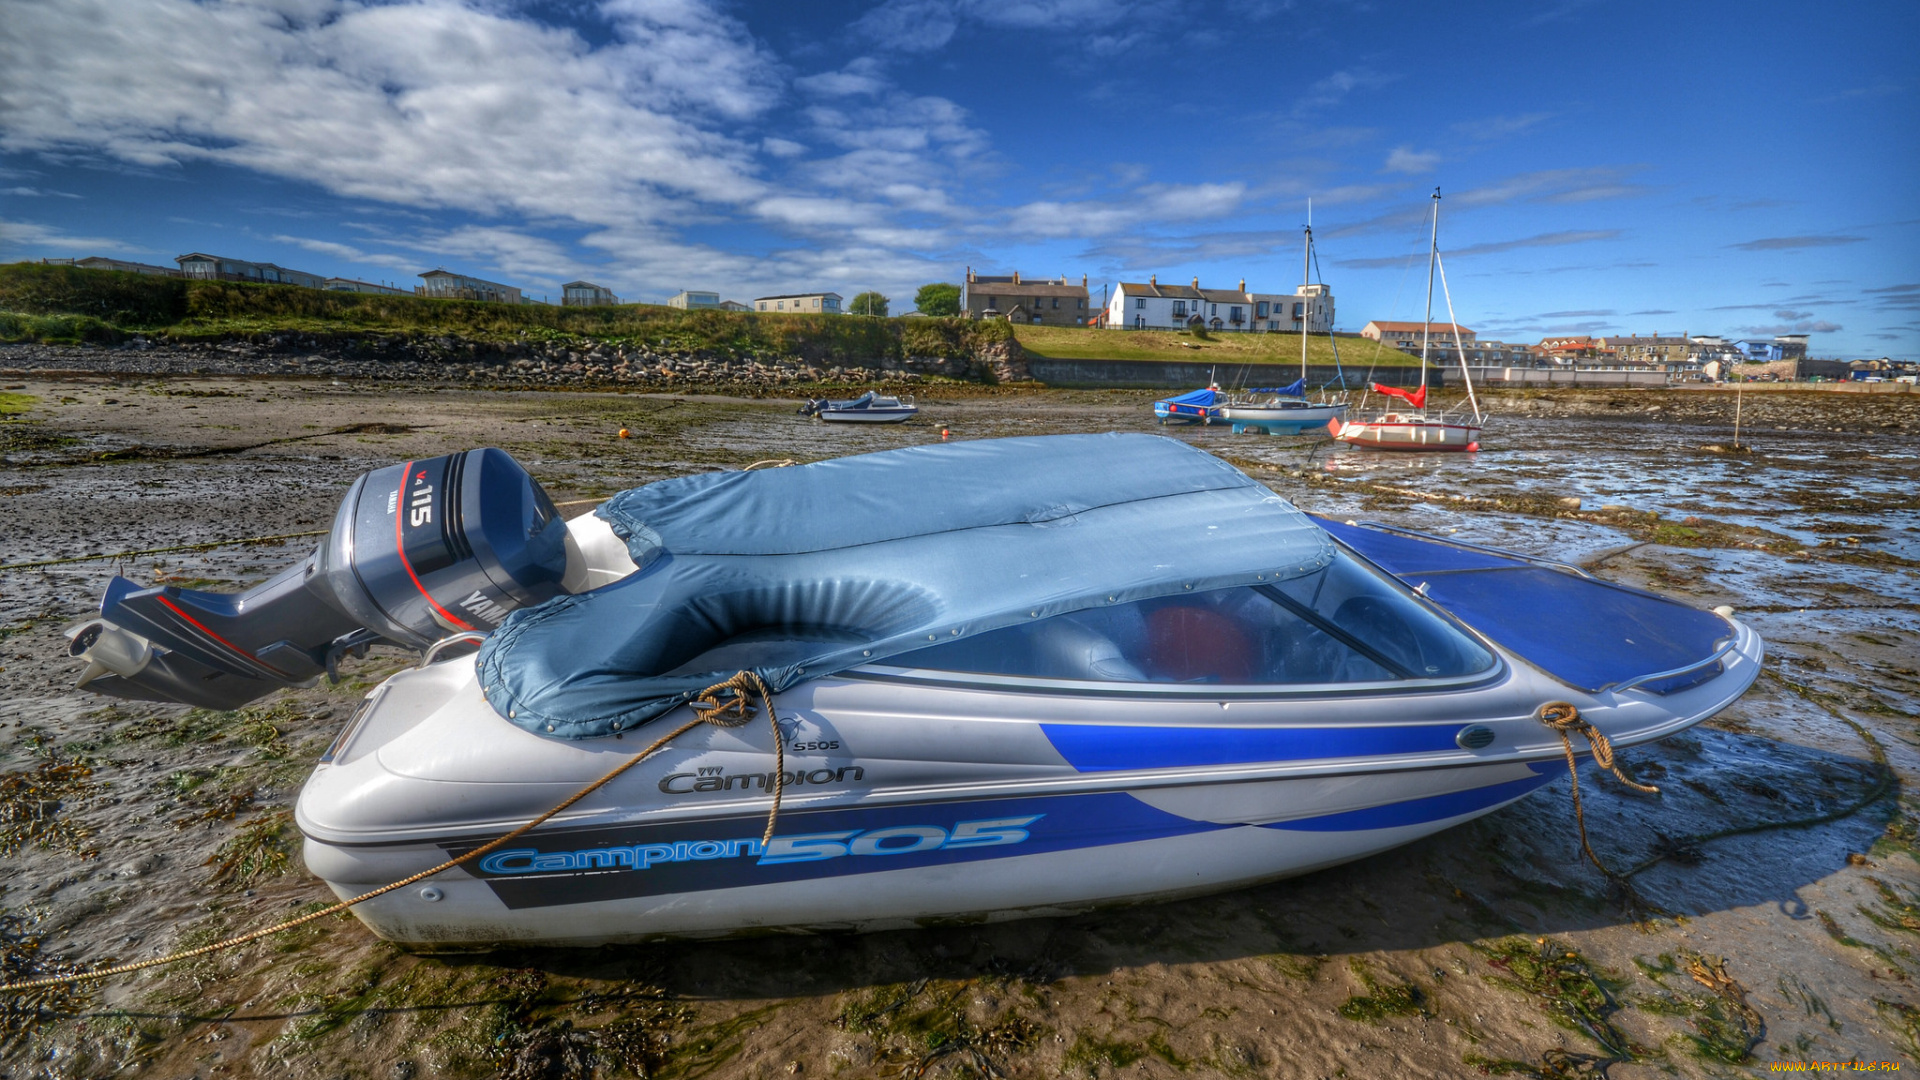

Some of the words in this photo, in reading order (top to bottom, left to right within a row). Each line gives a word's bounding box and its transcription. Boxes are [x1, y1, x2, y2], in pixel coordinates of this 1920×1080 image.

[386, 489, 399, 515] YAMAHA
[410, 484, 433, 527] 115
[793, 740, 840, 752] S505
[657, 765, 865, 795] Campion
[479, 835, 766, 874] Campion
[756, 813, 1048, 866] 505
